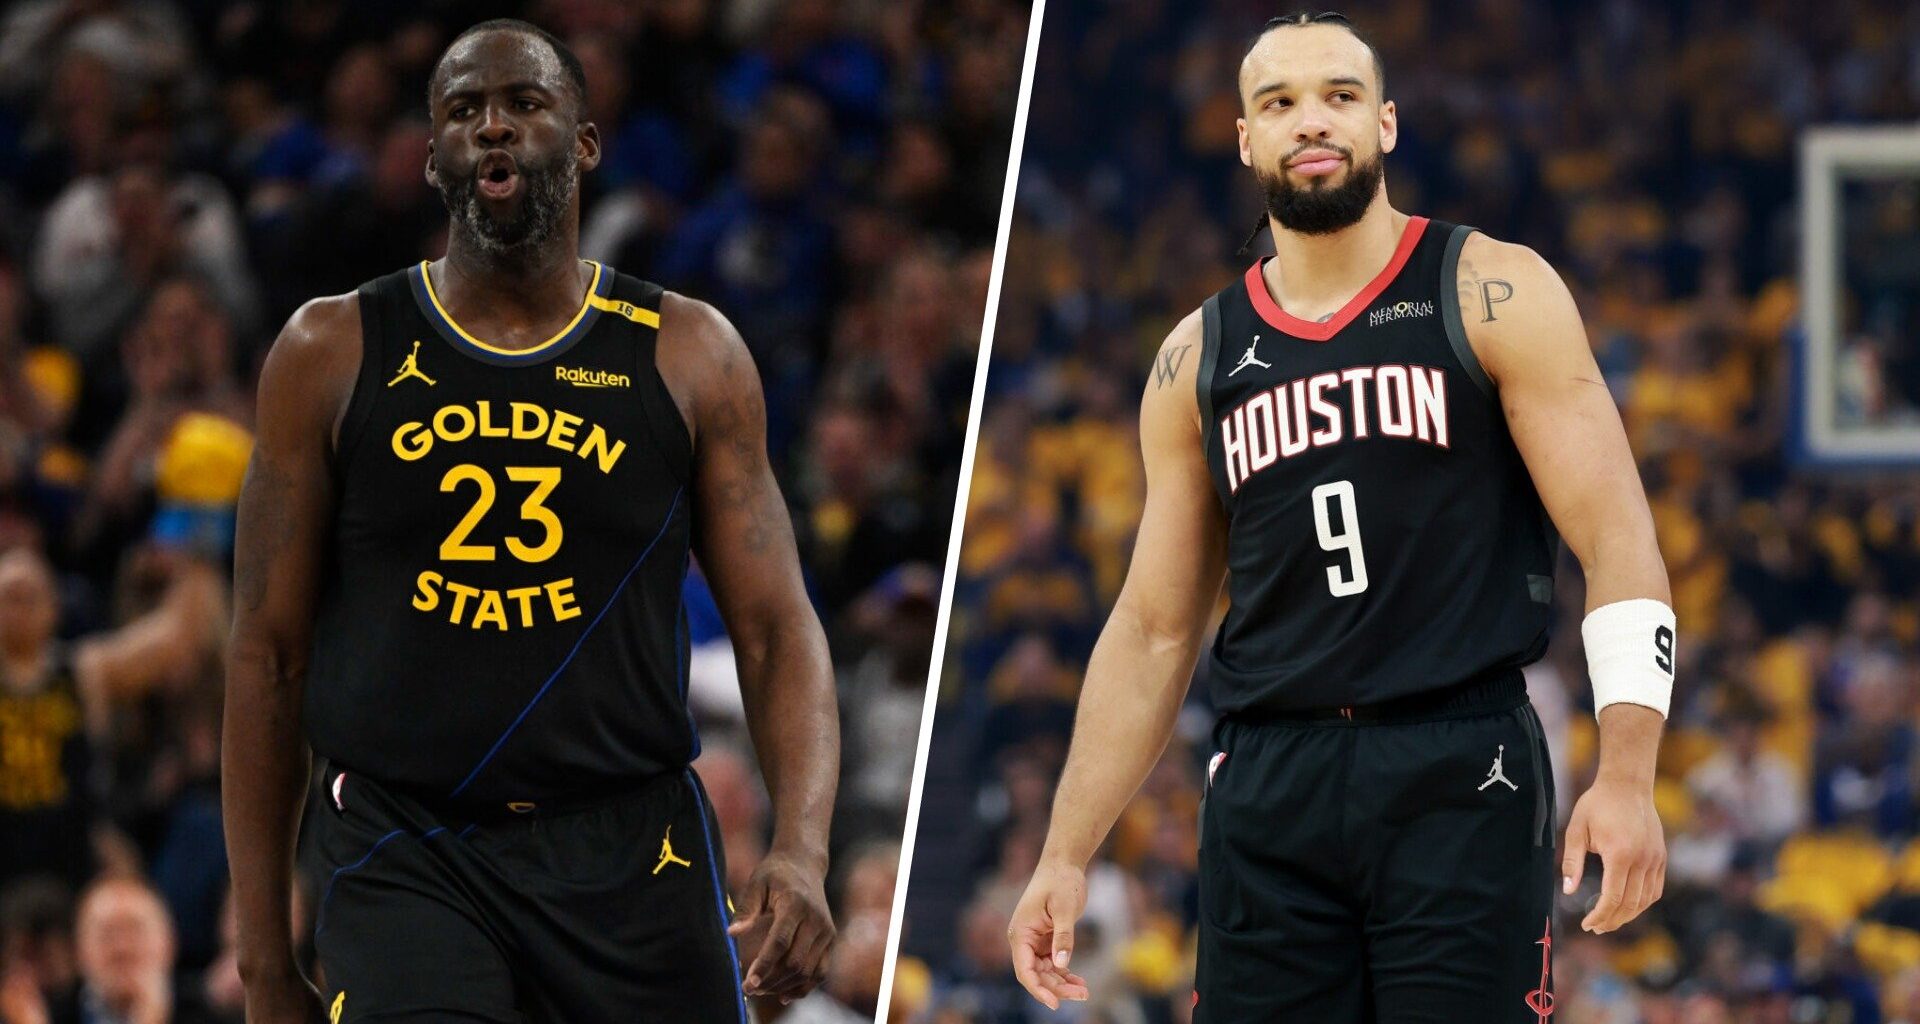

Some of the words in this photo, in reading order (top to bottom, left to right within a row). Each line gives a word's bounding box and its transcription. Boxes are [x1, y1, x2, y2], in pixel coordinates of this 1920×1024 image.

[617, 303, 633, 317] 16
[1370, 300, 1433, 318] MEMORIAL
[1370, 306, 1433, 327] HERMANN
[1475, 278, 1513, 323] P
[555, 366, 630, 387] Rakuten
[1157, 344, 1192, 389] W
[391, 400, 627, 474] GOLDEN
[1221, 364, 1450, 496] HOUSTON
[439, 464, 563, 563] 23
[1311, 480, 1368, 598] 9
[412, 570, 582, 631] STATE
[1655, 625, 1673, 676] 9
